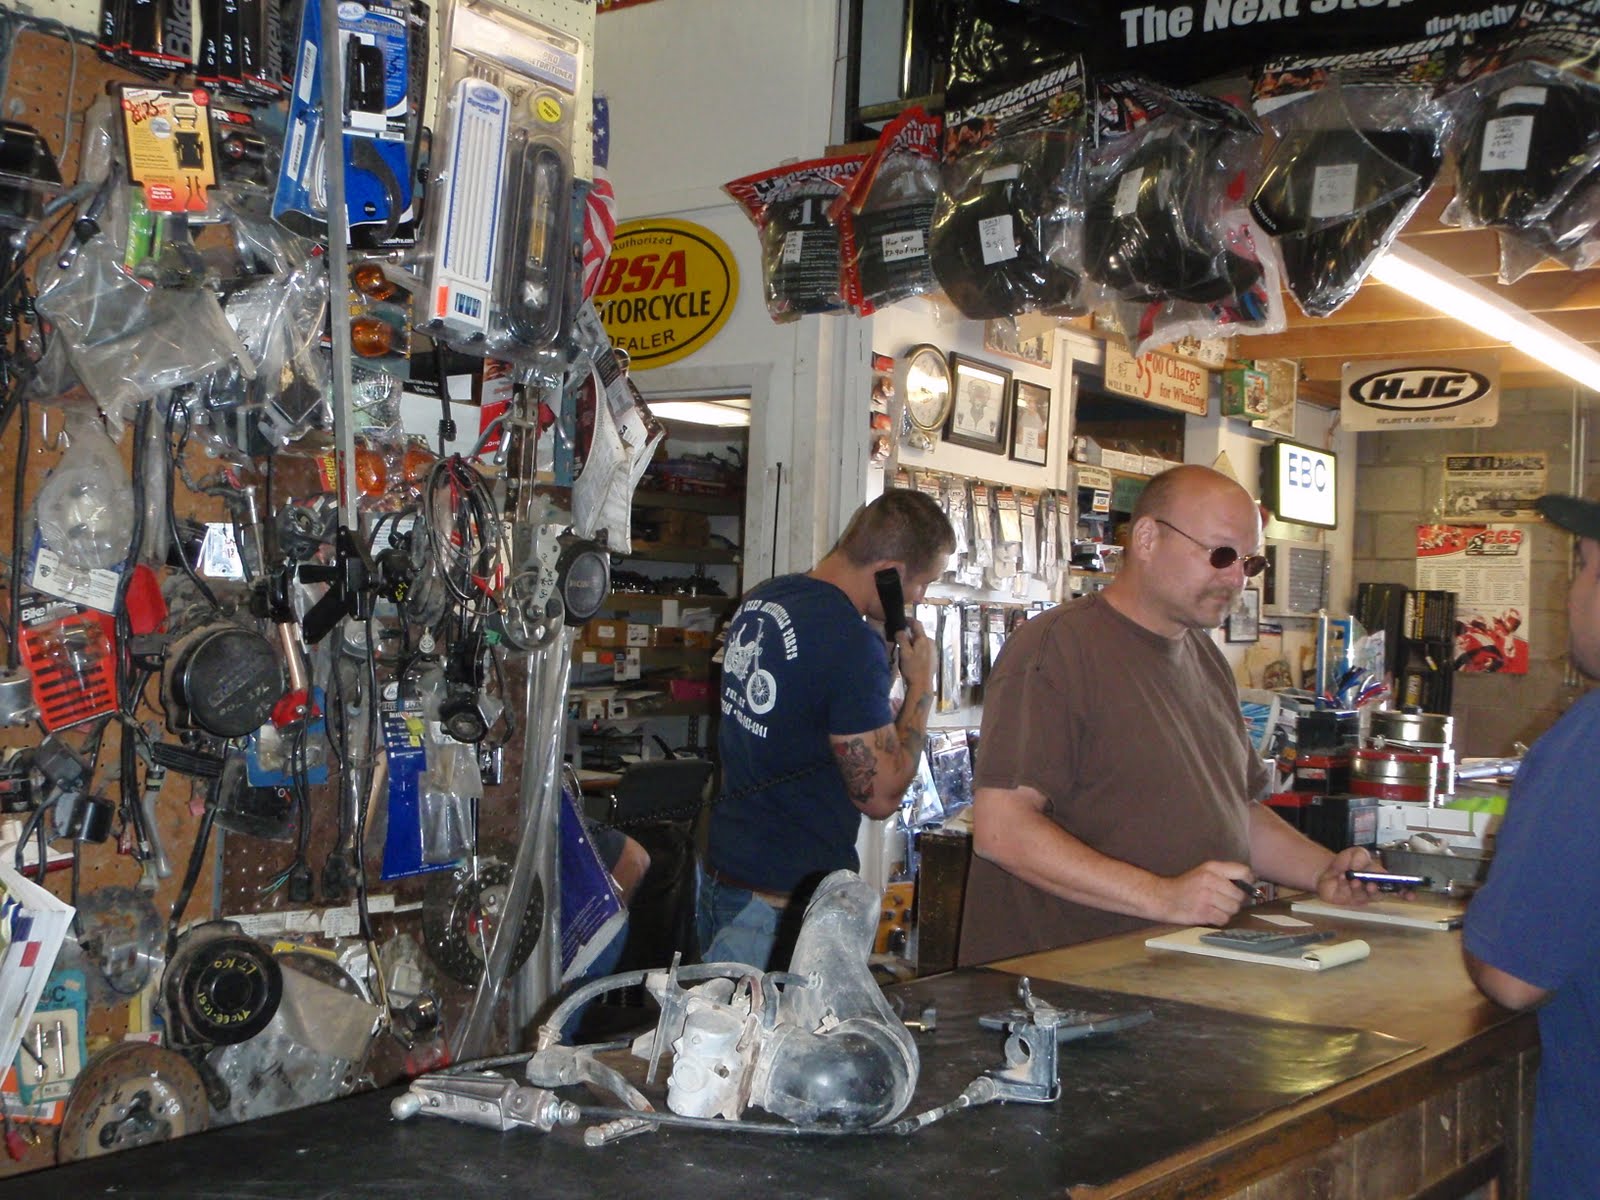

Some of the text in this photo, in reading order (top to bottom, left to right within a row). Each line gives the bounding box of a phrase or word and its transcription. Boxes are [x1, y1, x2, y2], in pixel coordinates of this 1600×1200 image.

[1120, 6, 1194, 48] The
[597, 249, 687, 297] BSA
[1159, 382, 1171, 398] for
[1165, 357, 1201, 392] Charge
[1369, 374, 1469, 401] HJC
[1288, 452, 1327, 493] EBC
[783, 627, 798, 661] PARTS
